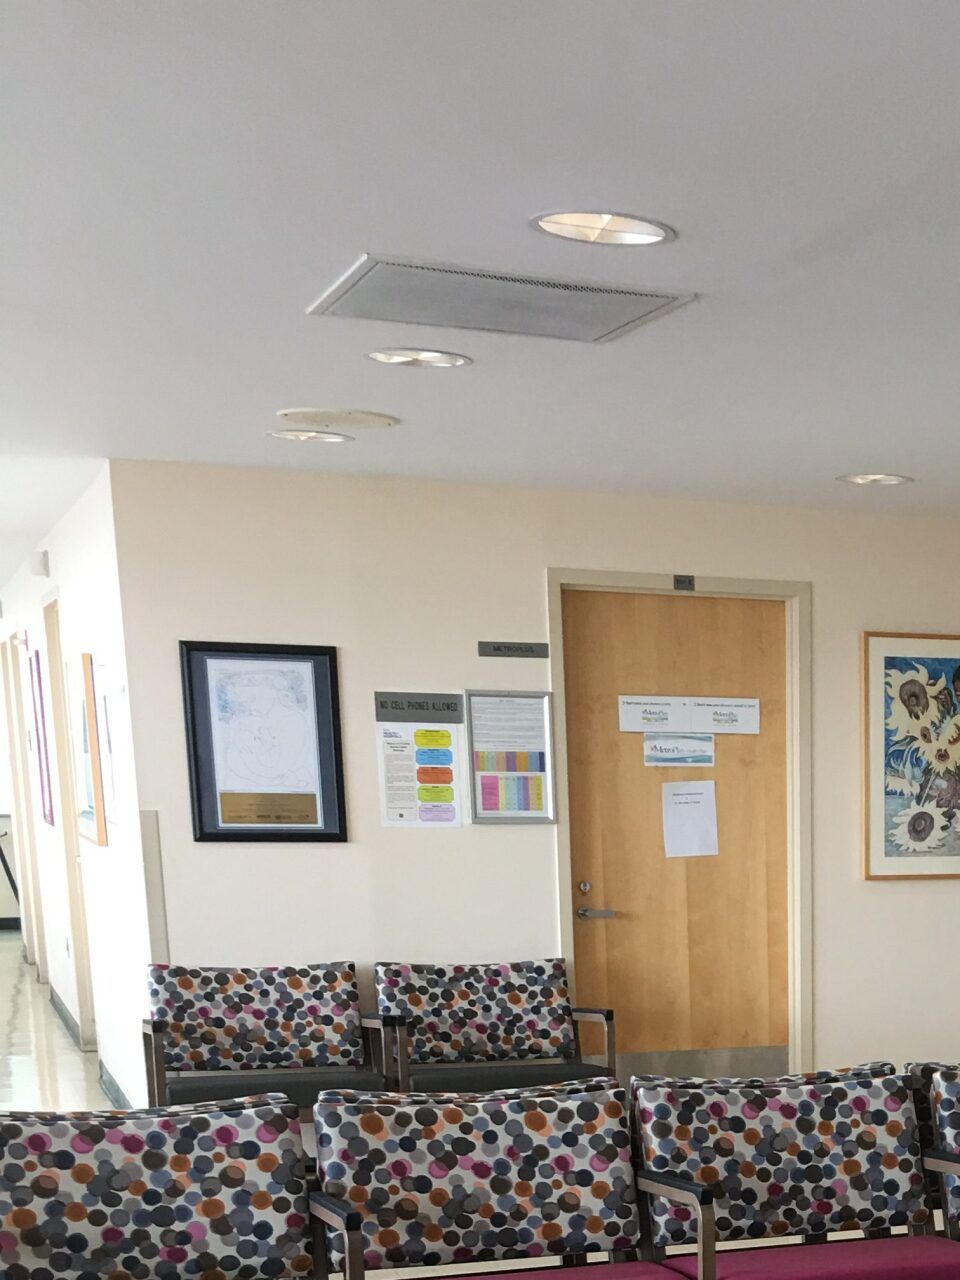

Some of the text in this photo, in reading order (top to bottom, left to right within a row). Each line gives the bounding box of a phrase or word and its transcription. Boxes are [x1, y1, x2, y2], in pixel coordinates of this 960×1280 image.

[380, 700, 457, 711] NO CELL PHONES ALLOWED
